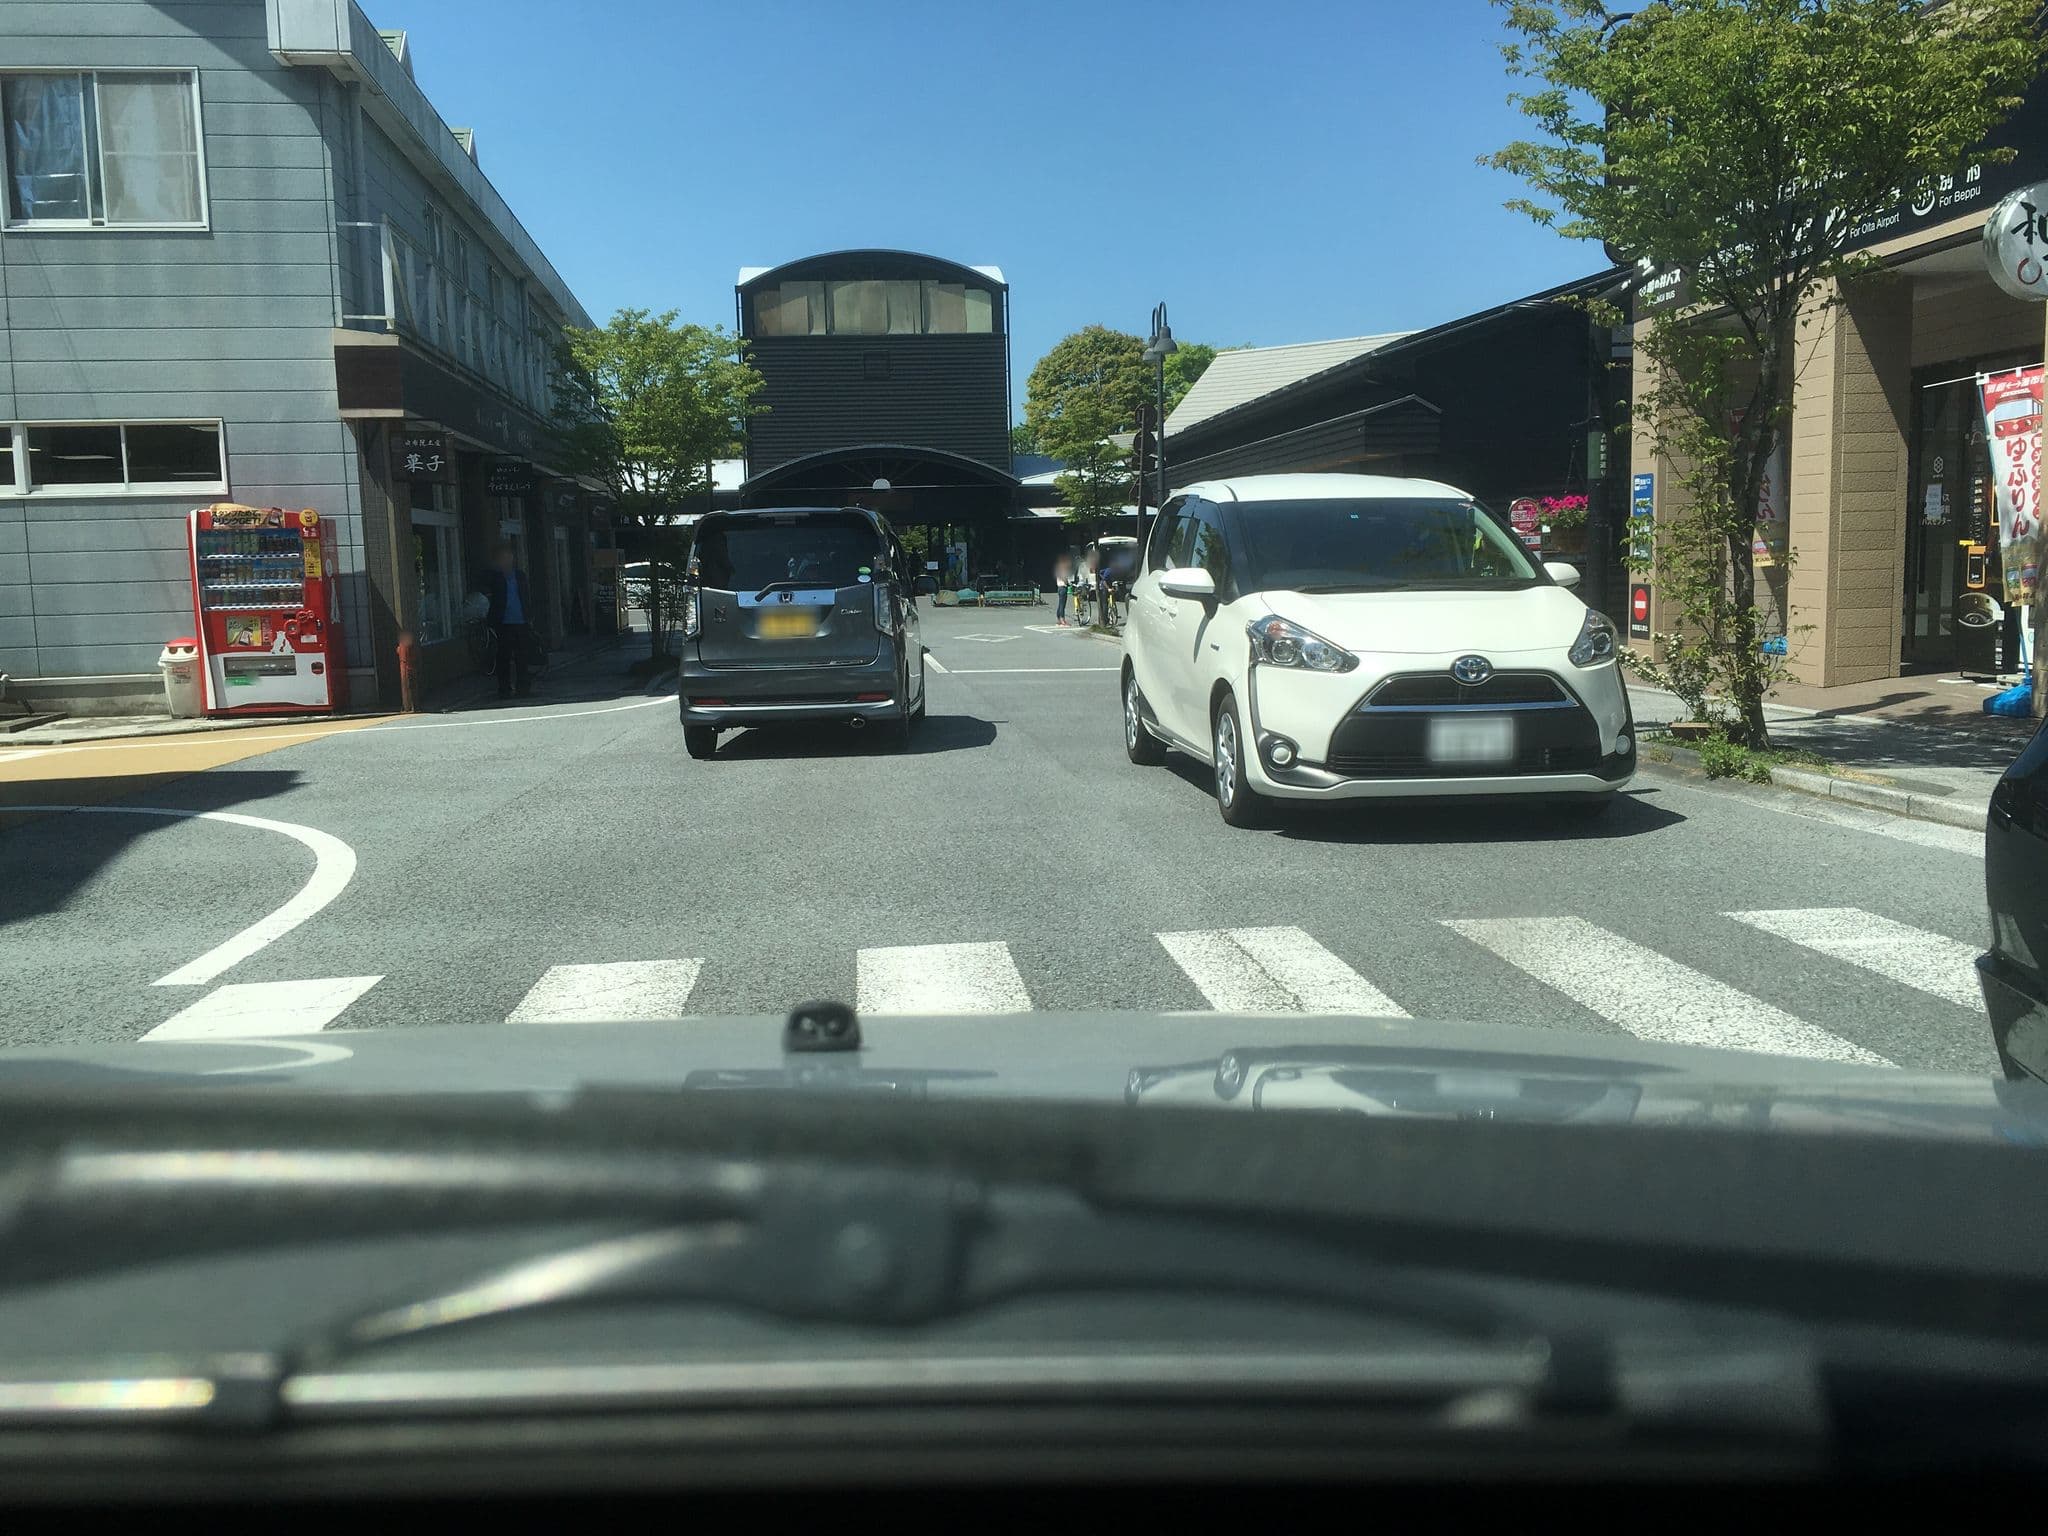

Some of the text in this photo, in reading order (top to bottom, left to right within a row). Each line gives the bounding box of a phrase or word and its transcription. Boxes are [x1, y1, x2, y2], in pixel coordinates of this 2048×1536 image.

[1939, 186, 1981, 208] For Beppu
[1850, 212, 1900, 239] For Oita Airport
[403, 453, 445, 473] 菓子
